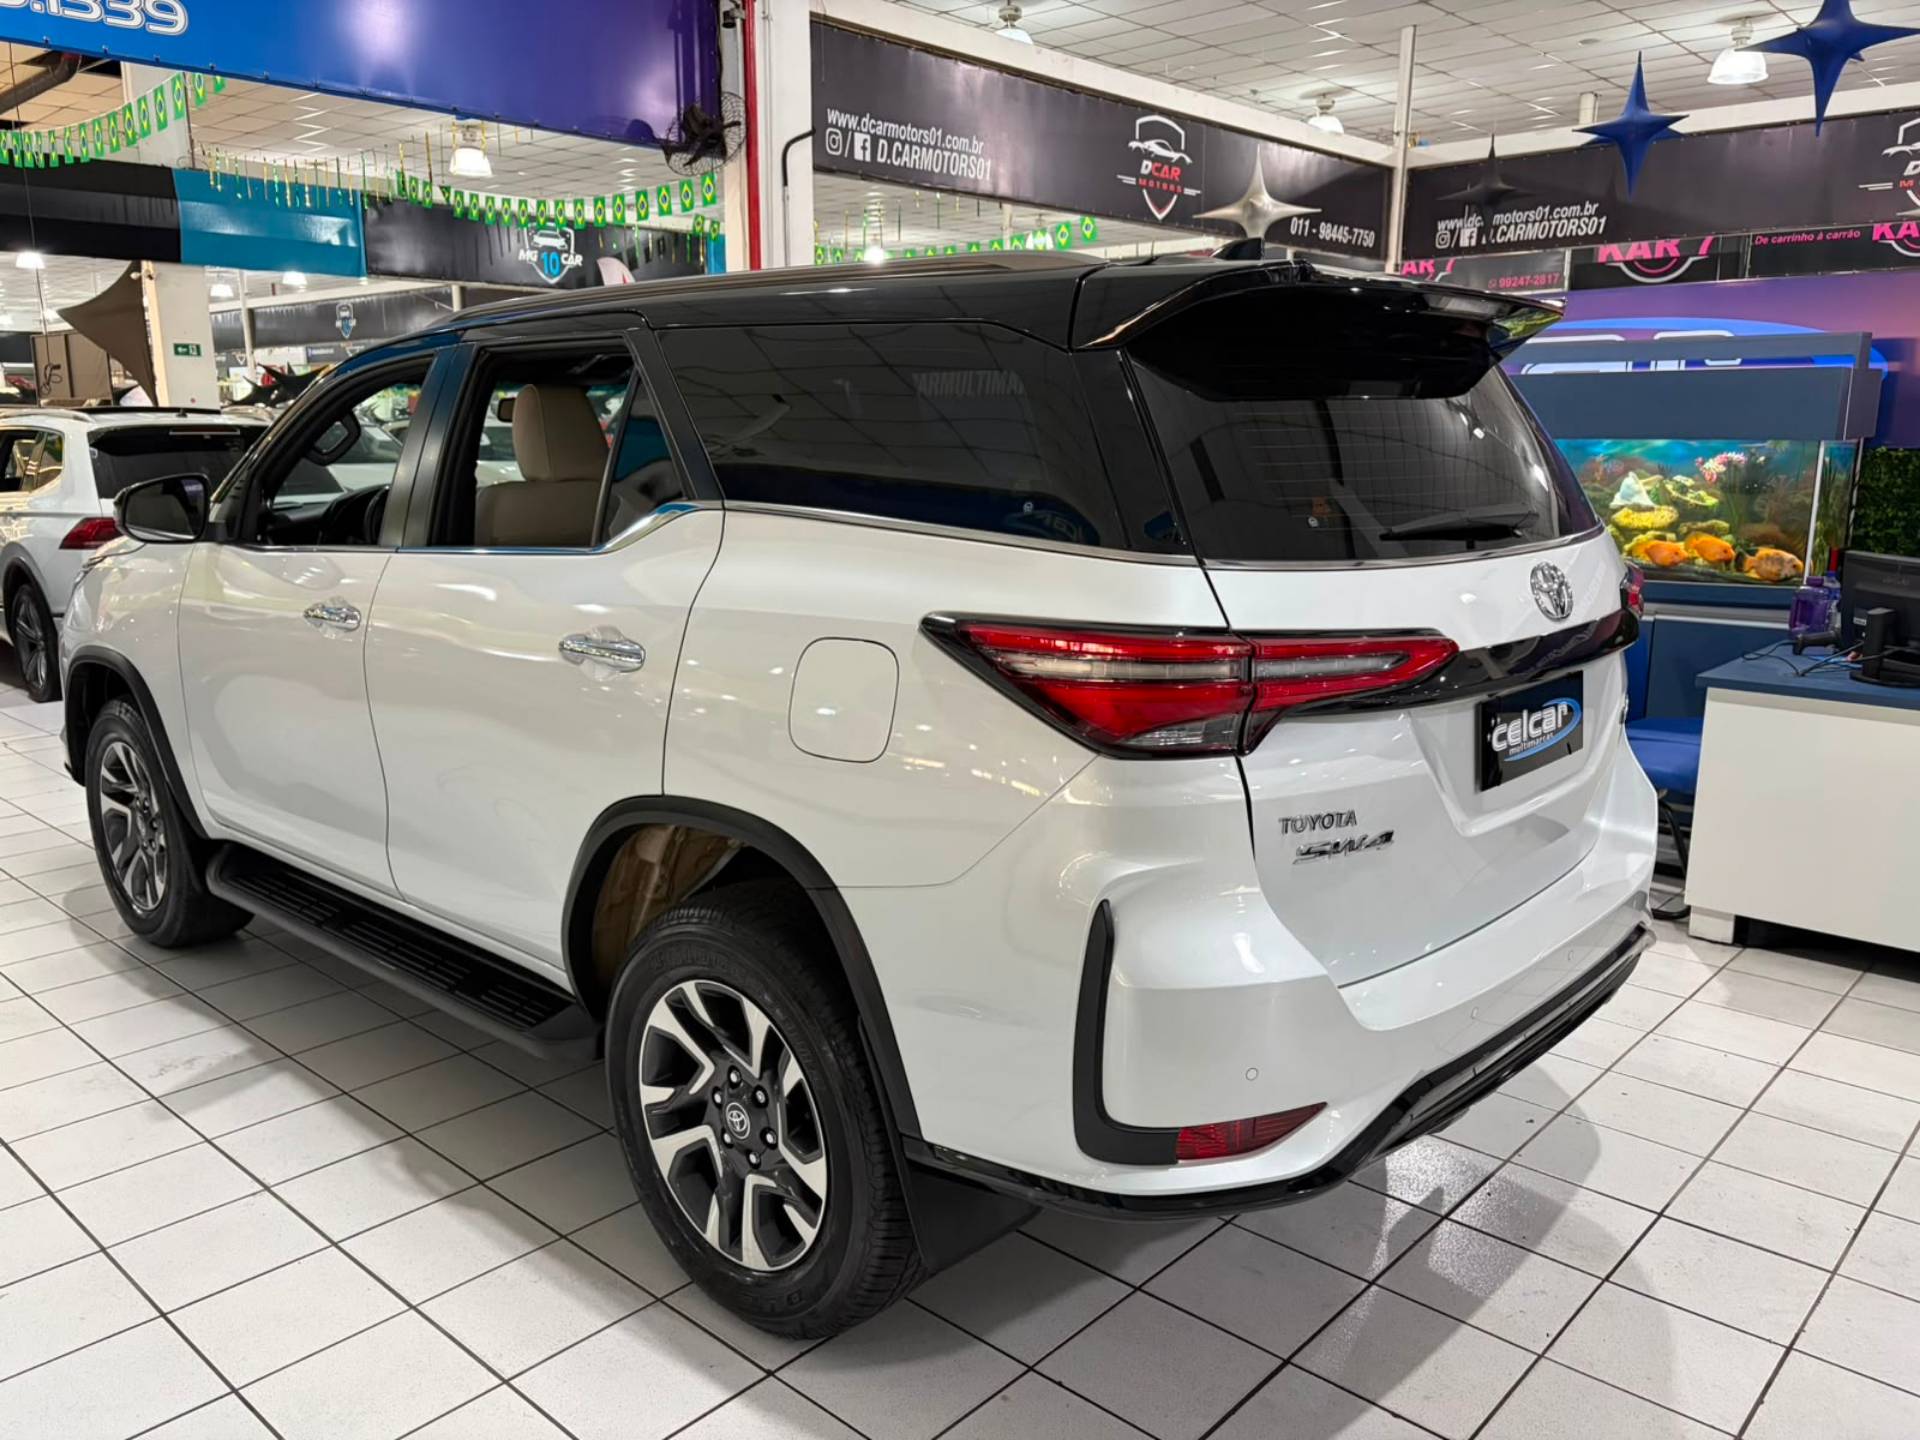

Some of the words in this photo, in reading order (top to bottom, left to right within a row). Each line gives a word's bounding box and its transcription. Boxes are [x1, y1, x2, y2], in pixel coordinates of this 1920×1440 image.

[826, 107, 984, 155] www.dcarmotors01.com.br
[876, 138, 992, 181] D.CARMOTORS01
[1138, 178, 1183, 194] MOTORS
[1437, 200, 1599, 231] www.dcmotors01.com.br
[1290, 216, 1311, 237] 011
[1318, 221, 1375, 249] 98445-7750
[1754, 235, 1769, 246] De
[1771, 232, 1815, 245] carrinho
[1825, 228, 1862, 241] carrão
[518, 249, 539, 262] MG
[542, 251, 561, 277] 10
[560, 253, 584, 267] CAR
[1491, 702, 1568, 752] celcar
[1278, 809, 1358, 834] TOYOTA
[1292, 829, 1395, 865] SW4
